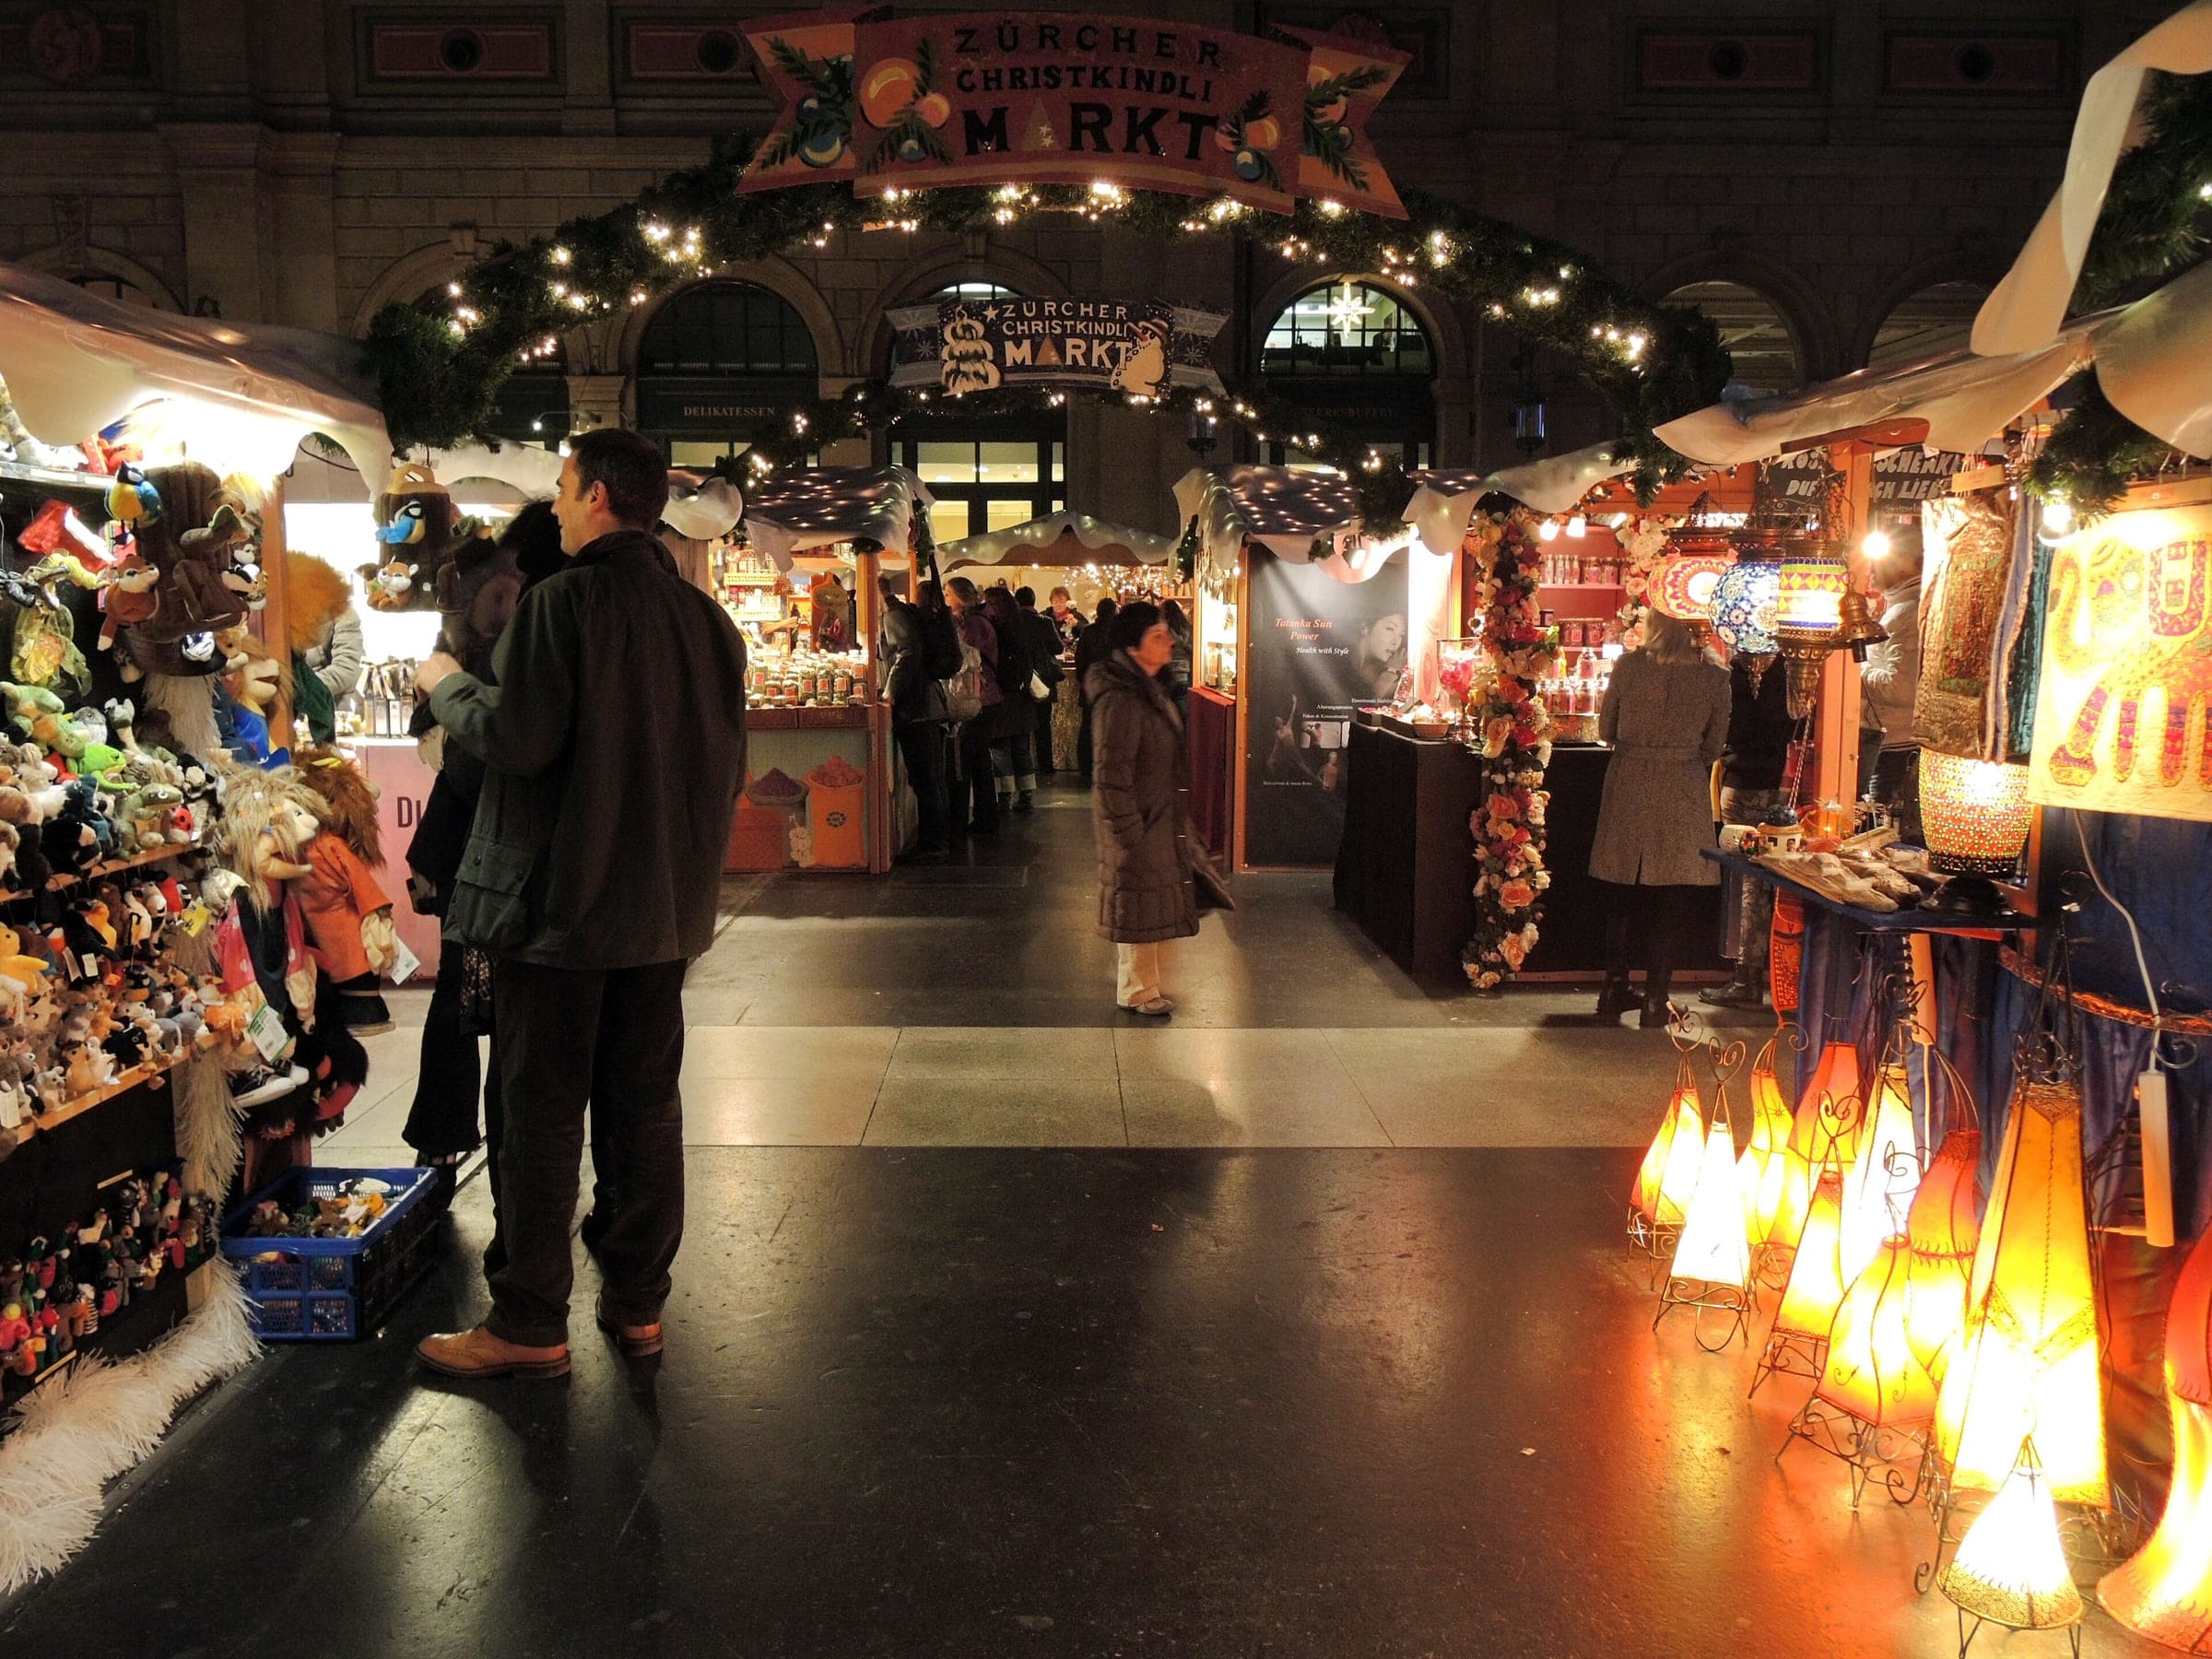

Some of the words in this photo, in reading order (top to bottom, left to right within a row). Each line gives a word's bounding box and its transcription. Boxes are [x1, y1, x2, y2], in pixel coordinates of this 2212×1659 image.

[954, 19, 1222, 67] ZÜRCHER
[957, 65, 1213, 102] CHRISTKINDLI
[1002, 320, 1128, 337] CHRISTKINDLI
[683, 406, 776, 417] DELIKATESSEN
[1275, 618, 1312, 628] Tatanka
[1312, 618, 1334, 629] Sun
[1290, 630, 1319, 641] Power
[1318, 646, 1333, 654] with
[1333, 646, 1349, 656] Style
